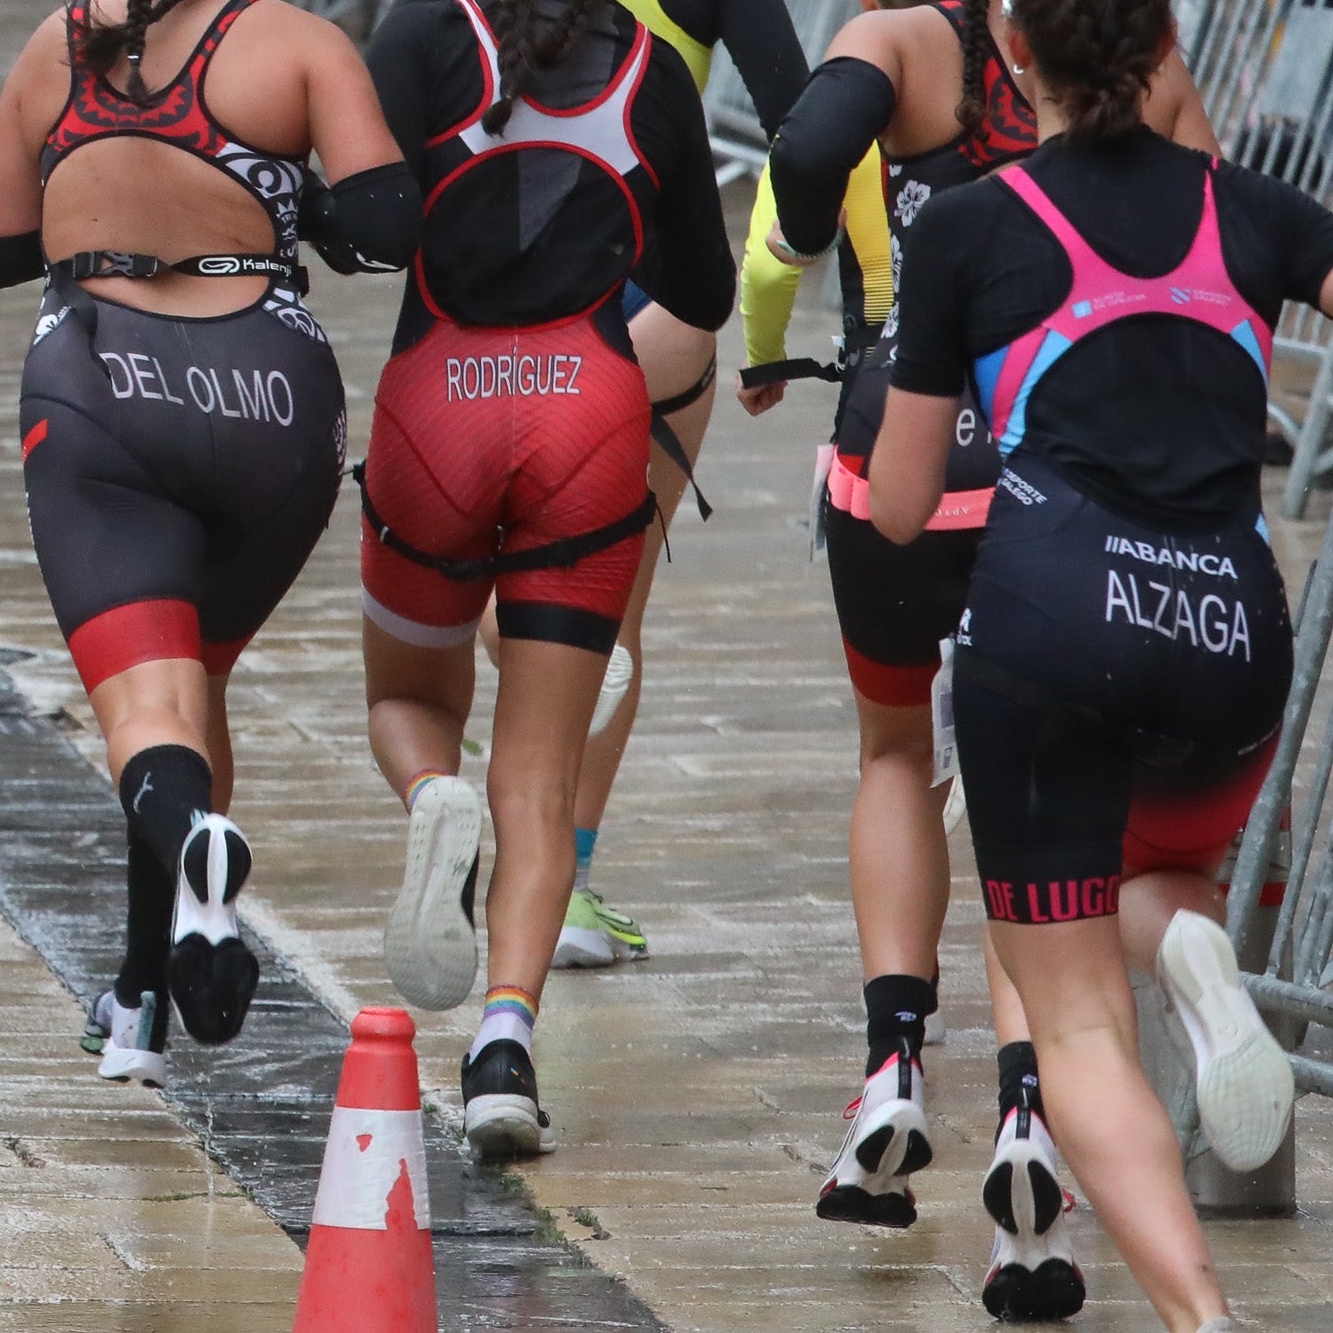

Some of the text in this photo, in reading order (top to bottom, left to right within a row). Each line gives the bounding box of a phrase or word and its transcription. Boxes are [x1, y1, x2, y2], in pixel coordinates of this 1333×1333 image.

[242, 258, 293, 277] Kalenji
[99, 352, 294, 427] DEL OLMO
[447, 346, 582, 403] RODRÍGUEZ
[1105, 569, 1251, 663] ALZAGA
[986, 875, 1120, 922] DE LUGO
